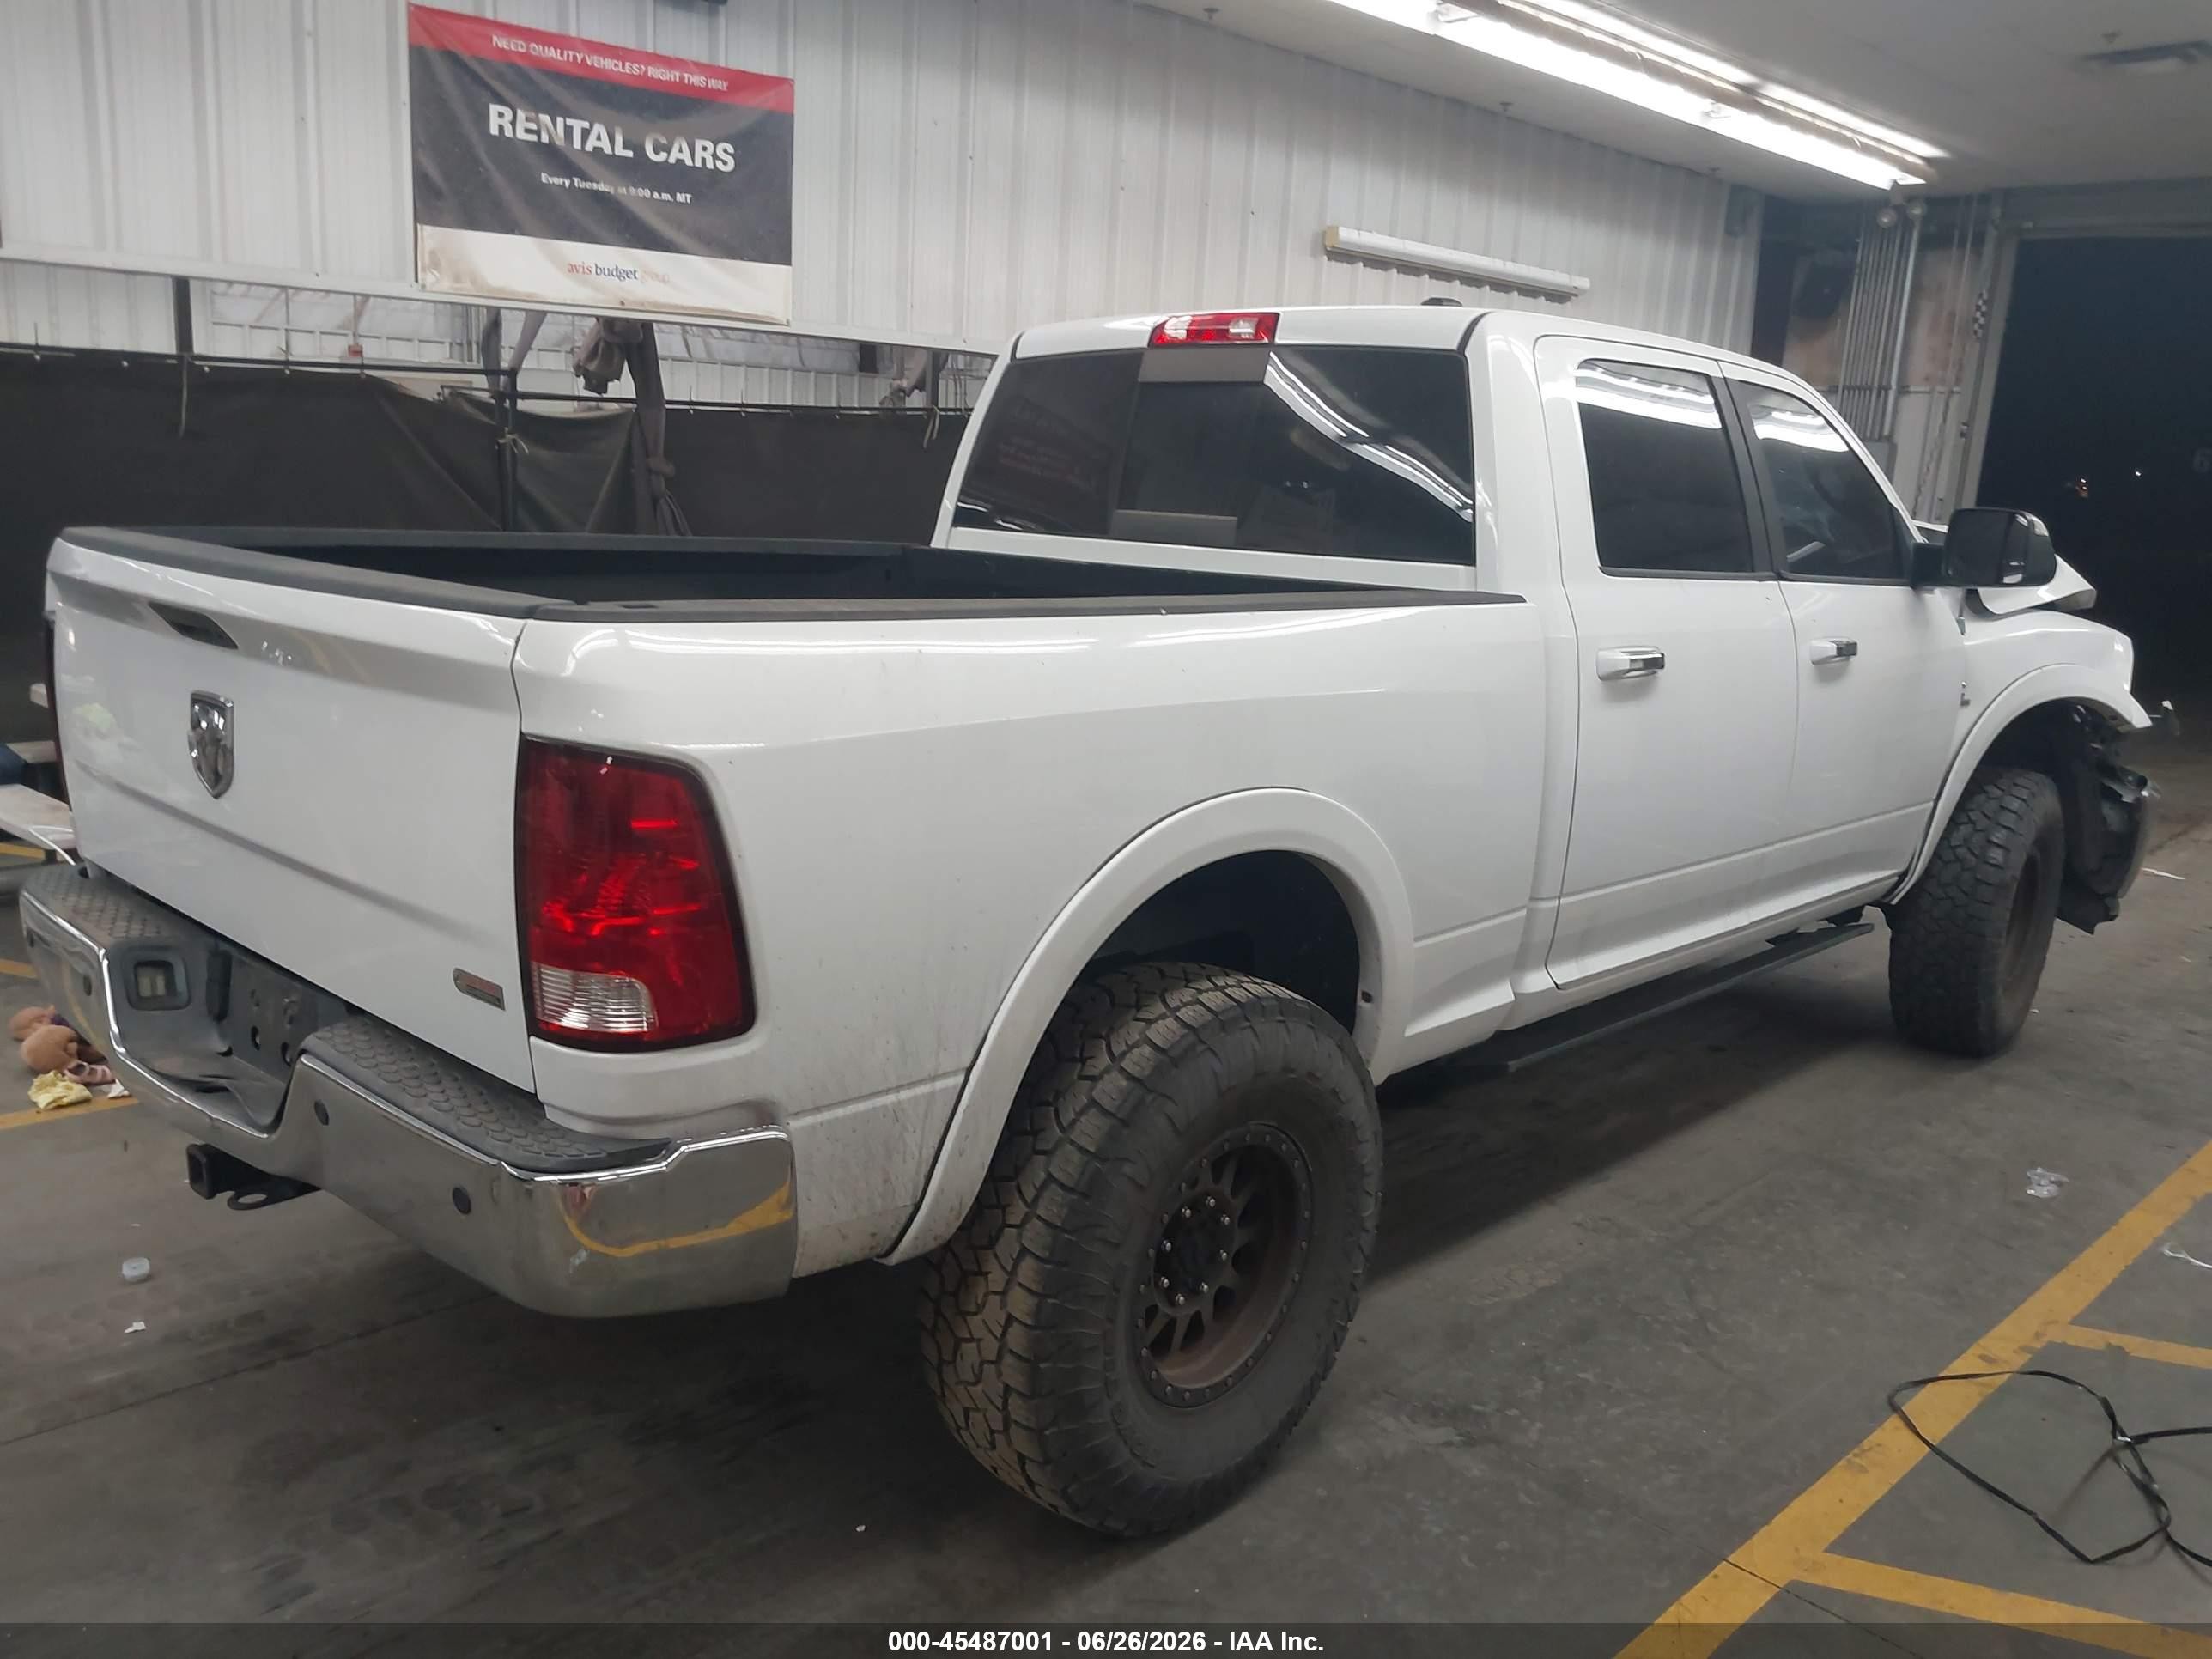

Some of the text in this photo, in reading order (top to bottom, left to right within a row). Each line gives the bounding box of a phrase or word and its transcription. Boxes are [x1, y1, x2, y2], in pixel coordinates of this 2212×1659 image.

[492, 34, 728, 91] NEED QUALITY VEHICLES? RIGHT THIS WAY
[488, 103, 736, 173] RENTAL CARS
[541, 172, 570, 189] Every
[573, 177, 615, 195] Tuesday
[676, 191, 692, 204] MT
[568, 262, 592, 275] avis
[594, 264, 638, 282] budget
